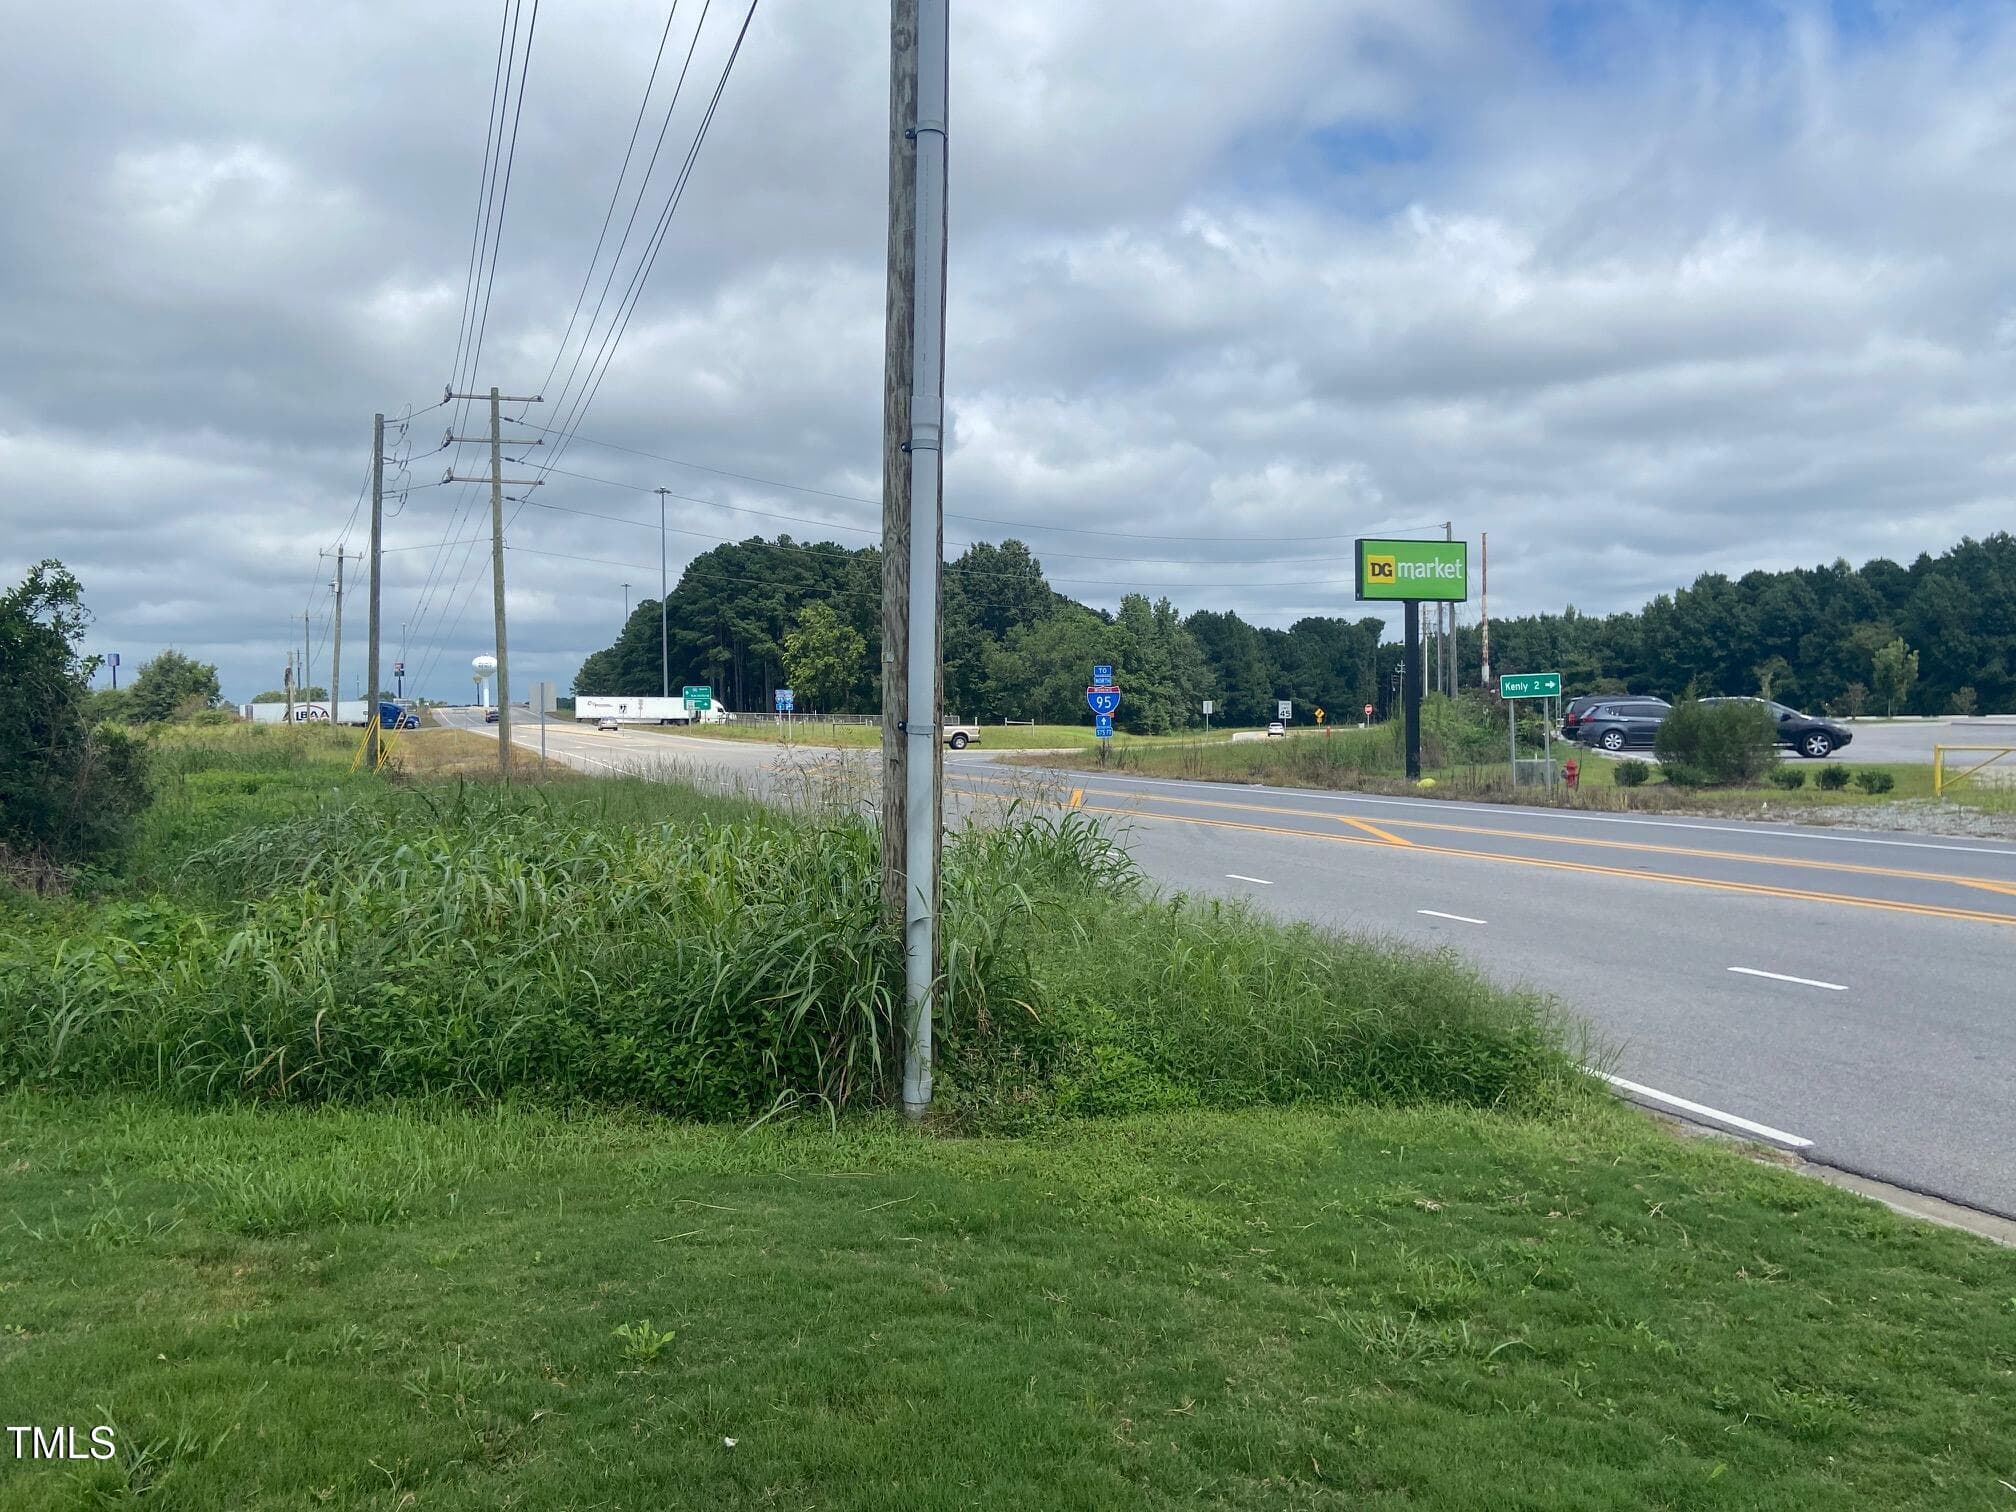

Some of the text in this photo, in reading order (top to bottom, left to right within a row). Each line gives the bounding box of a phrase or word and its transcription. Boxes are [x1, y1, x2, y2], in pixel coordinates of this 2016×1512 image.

[1370, 562, 1393, 577] DG
[1397, 557, 1462, 580] market
[1504, 681, 1540, 693] Kenly 2
[1096, 696, 1111, 708] 95
